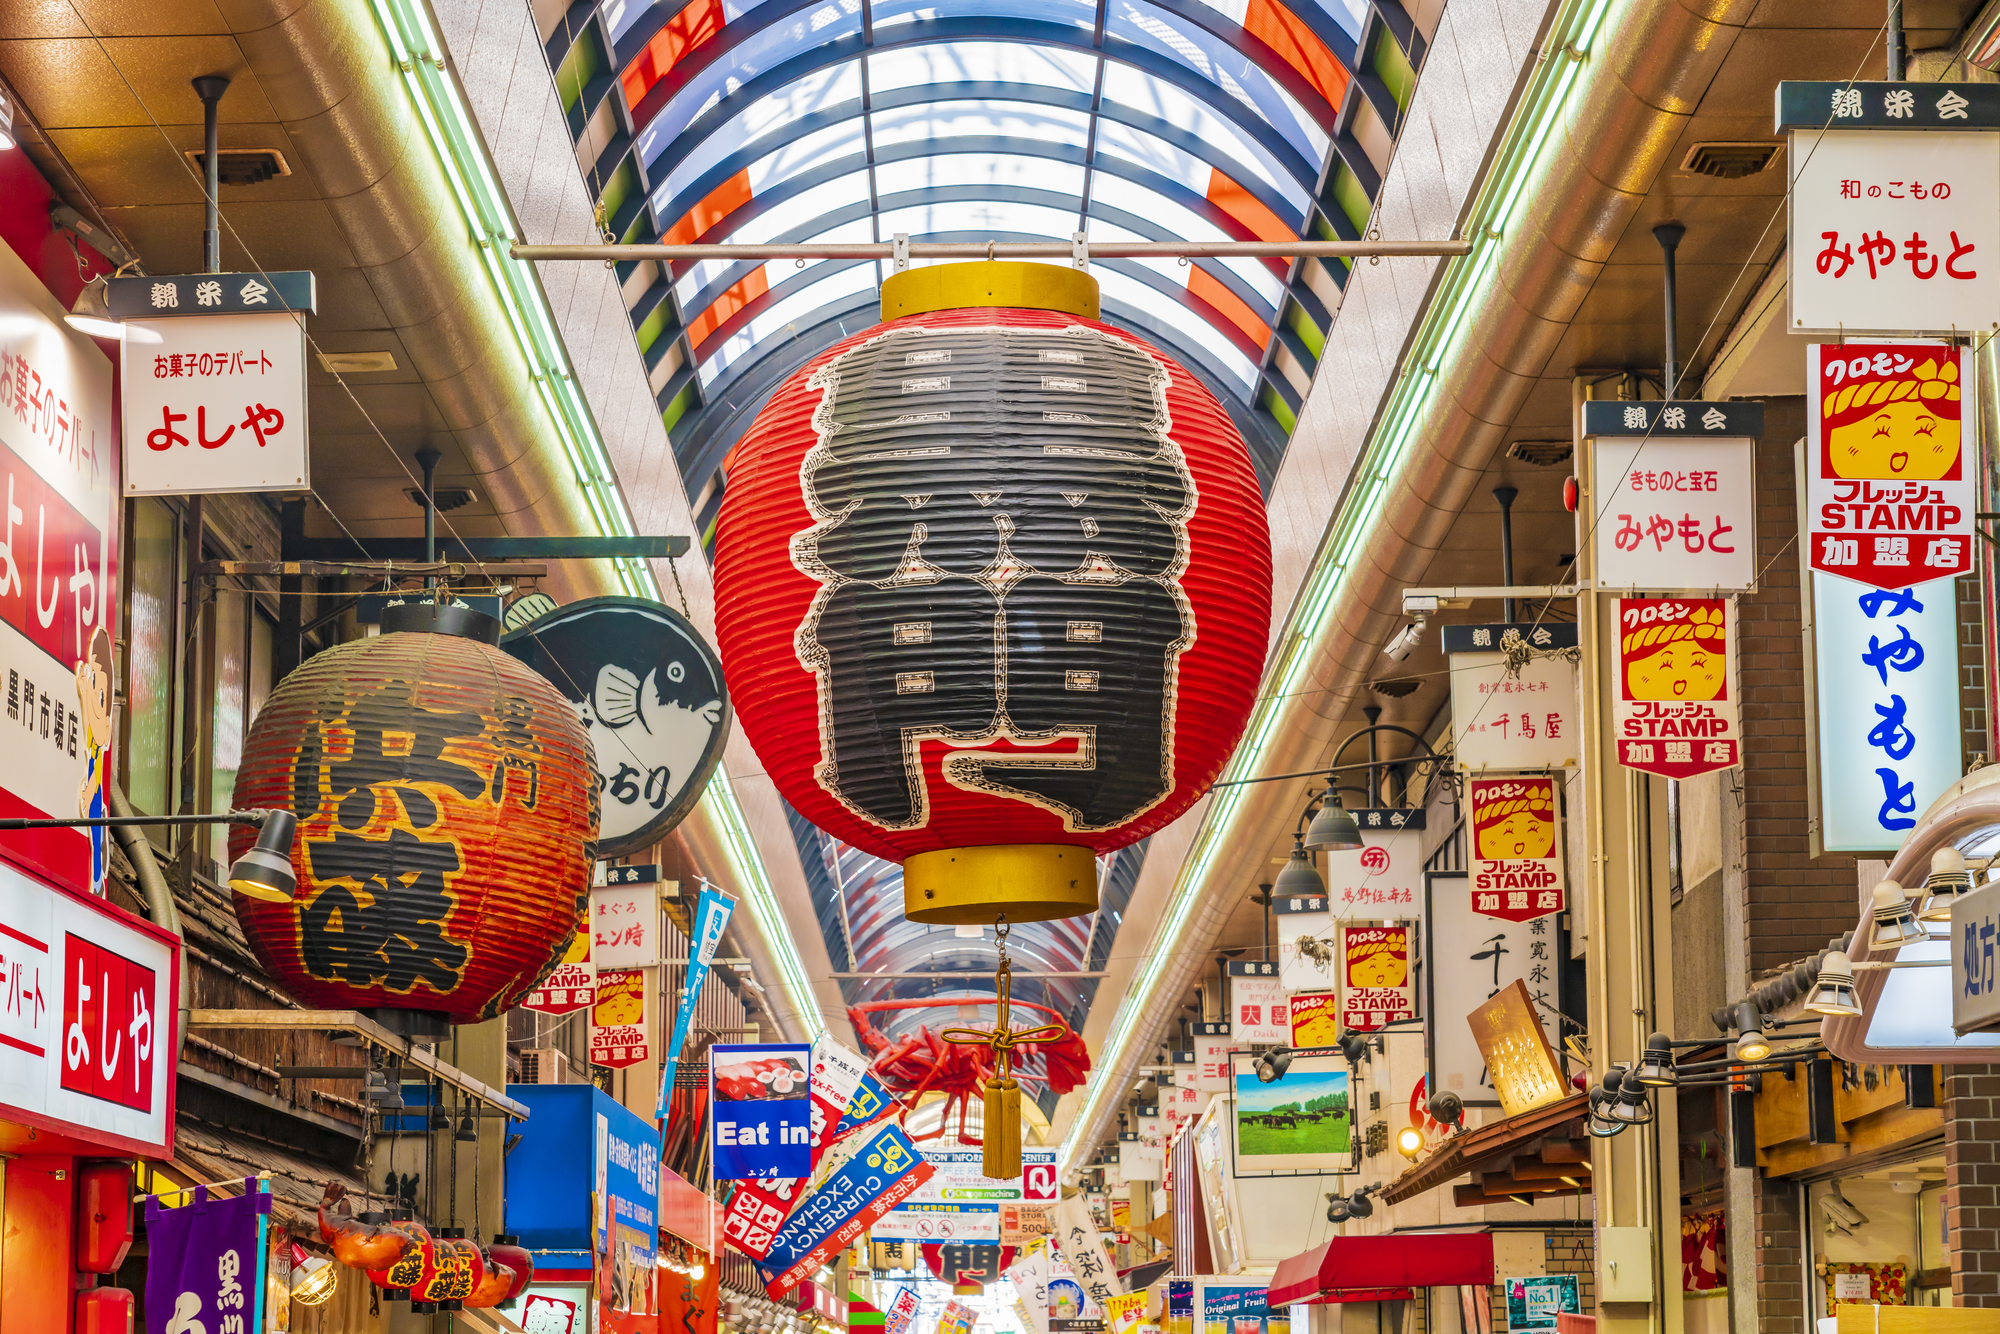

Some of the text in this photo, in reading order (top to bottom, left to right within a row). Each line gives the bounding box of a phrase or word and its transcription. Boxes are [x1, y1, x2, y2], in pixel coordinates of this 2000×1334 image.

[1831, 89, 1969, 119] 親栄会
[1840, 180, 1951, 200] 和のこもの
[1816, 230, 1977, 280] みやもと
[150, 279, 269, 309] 親栄会
[154, 349, 273, 379] お菓子のデパート
[1824, 352, 1915, 386] クロモン
[147, 403, 285, 452] よしや
[1623, 407, 1727, 431] 親栄会
[1630, 469, 1718, 493] きものと宝石
[1834, 482, 1945, 504] フレッシュ
[1821, 504, 1962, 531] STAMP
[1614, 512, 1735, 555] みやもと
[1821, 536, 1962, 569] 加盟店
[0, 473, 95, 659] よしや
[790, 326, 1200, 832] 黒門
[1623, 602, 1690, 629] クロモン
[1478, 681, 1549, 694] 創業寛永七年
[8, 668, 79, 760] 黒門市場店
[1631, 702, 1715, 718] フレッシュ
[1490, 712, 1563, 740] 千鳥屋
[1624, 718, 1728, 737] STAMP
[1626, 741, 1730, 764] 加盟店
[1474, 783, 1526, 804] クロモン
[1482, 860, 1547, 872] フレッシュ
[1476, 872, 1557, 889] STAMP
[1290, 898, 1329, 911] 親栄
[1477, 890, 1558, 910] 加盟店
[1348, 930, 1386, 946] クロモン
[1964, 914, 2000, 1000] 処方
[526, 989, 591, 1005] 加盟店
[1352, 988, 1400, 998] フレッシュ
[1292, 998, 1324, 1012] クロモン
[1347, 998, 1408, 1010] STAMP
[67, 957, 151, 1094] よしや
[597, 1026, 637, 1036] フレッシュ
[1253, 1030, 1279, 1038] Daiki
[593, 1034, 644, 1046] STAMP
[594, 1047, 645, 1060] 加盟店
[1203, 1063, 1236, 1079] 三都
[716, 1121, 770, 1146] Eat
[780, 1120, 809, 1145] in
[955, 1190, 983, 1199] Change
[790, 1175, 882, 1260] CURRENCY
[1021, 1224, 1042, 1233] 500
[1529, 1287, 1554, 1303] No.1
[1205, 1297, 1266, 1315] Original Fruit
